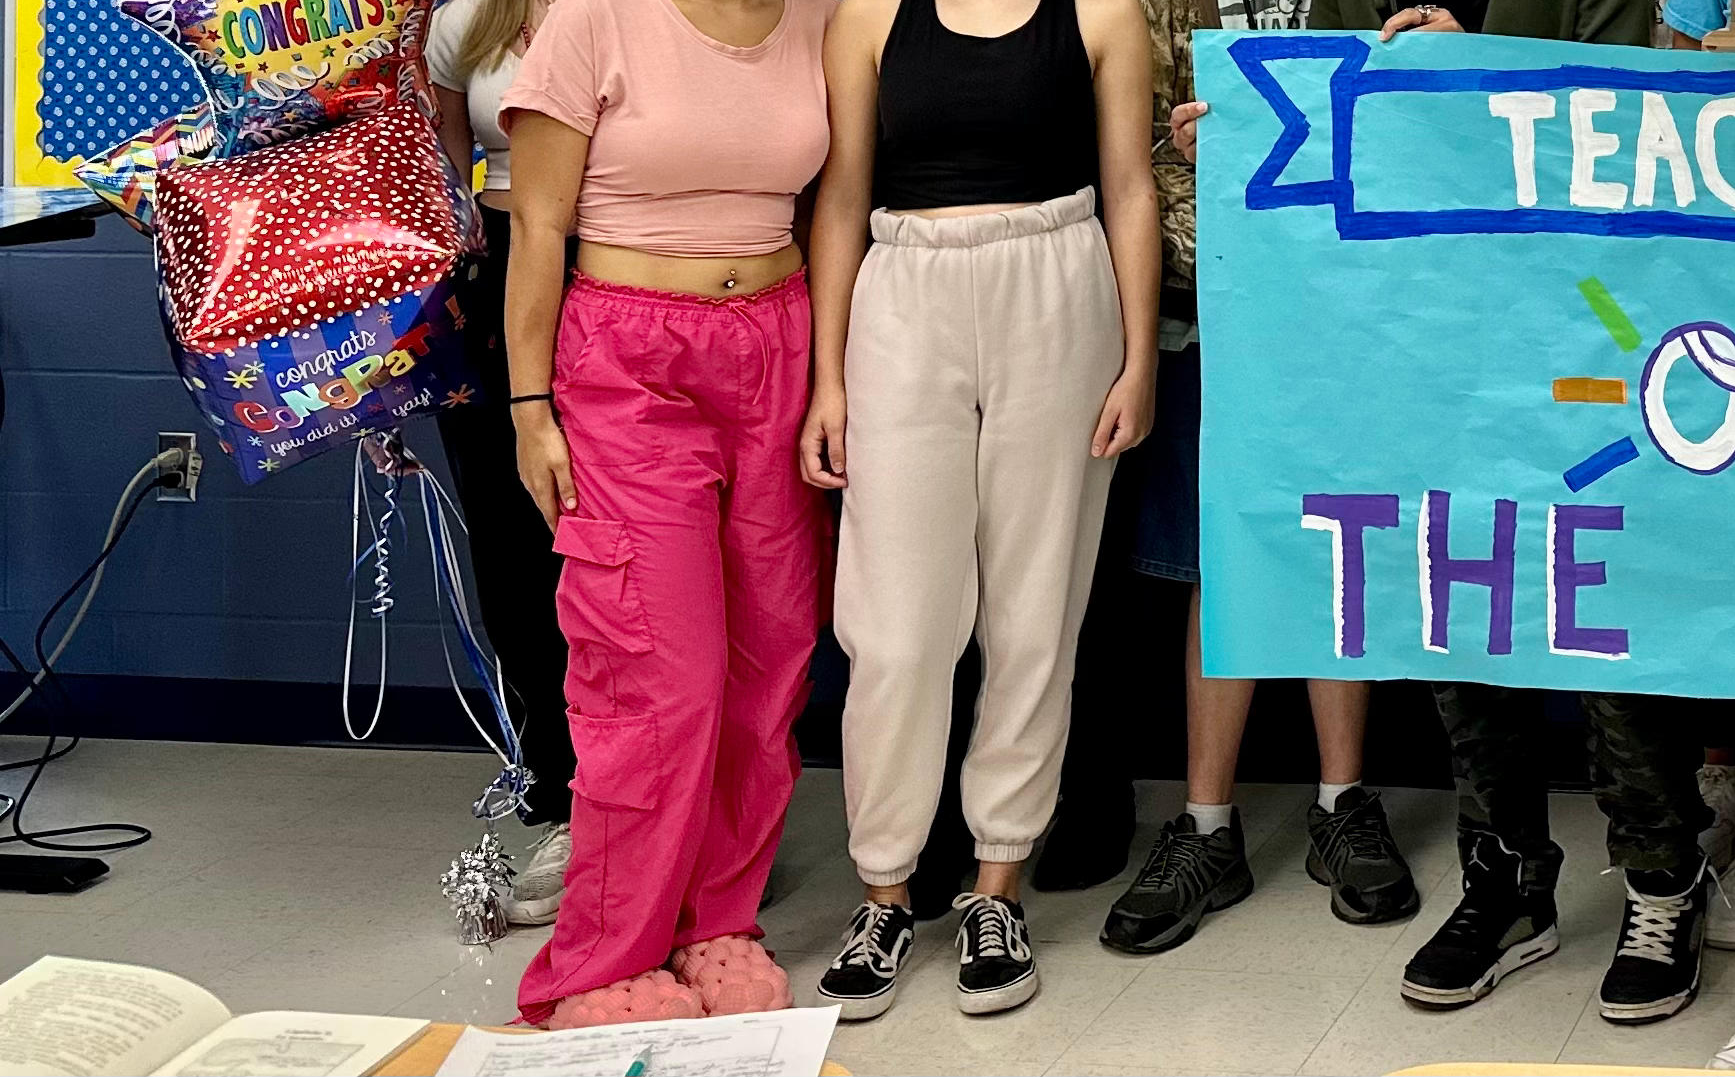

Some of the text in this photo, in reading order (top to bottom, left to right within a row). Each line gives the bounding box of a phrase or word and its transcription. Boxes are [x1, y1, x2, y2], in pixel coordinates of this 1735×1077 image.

[276, 330, 377, 388] congrats
[271, 437, 305, 457] you
[307, 421, 338, 442] did
[392, 388, 434, 417] yay!
[1302, 490, 1629, 662] THE
